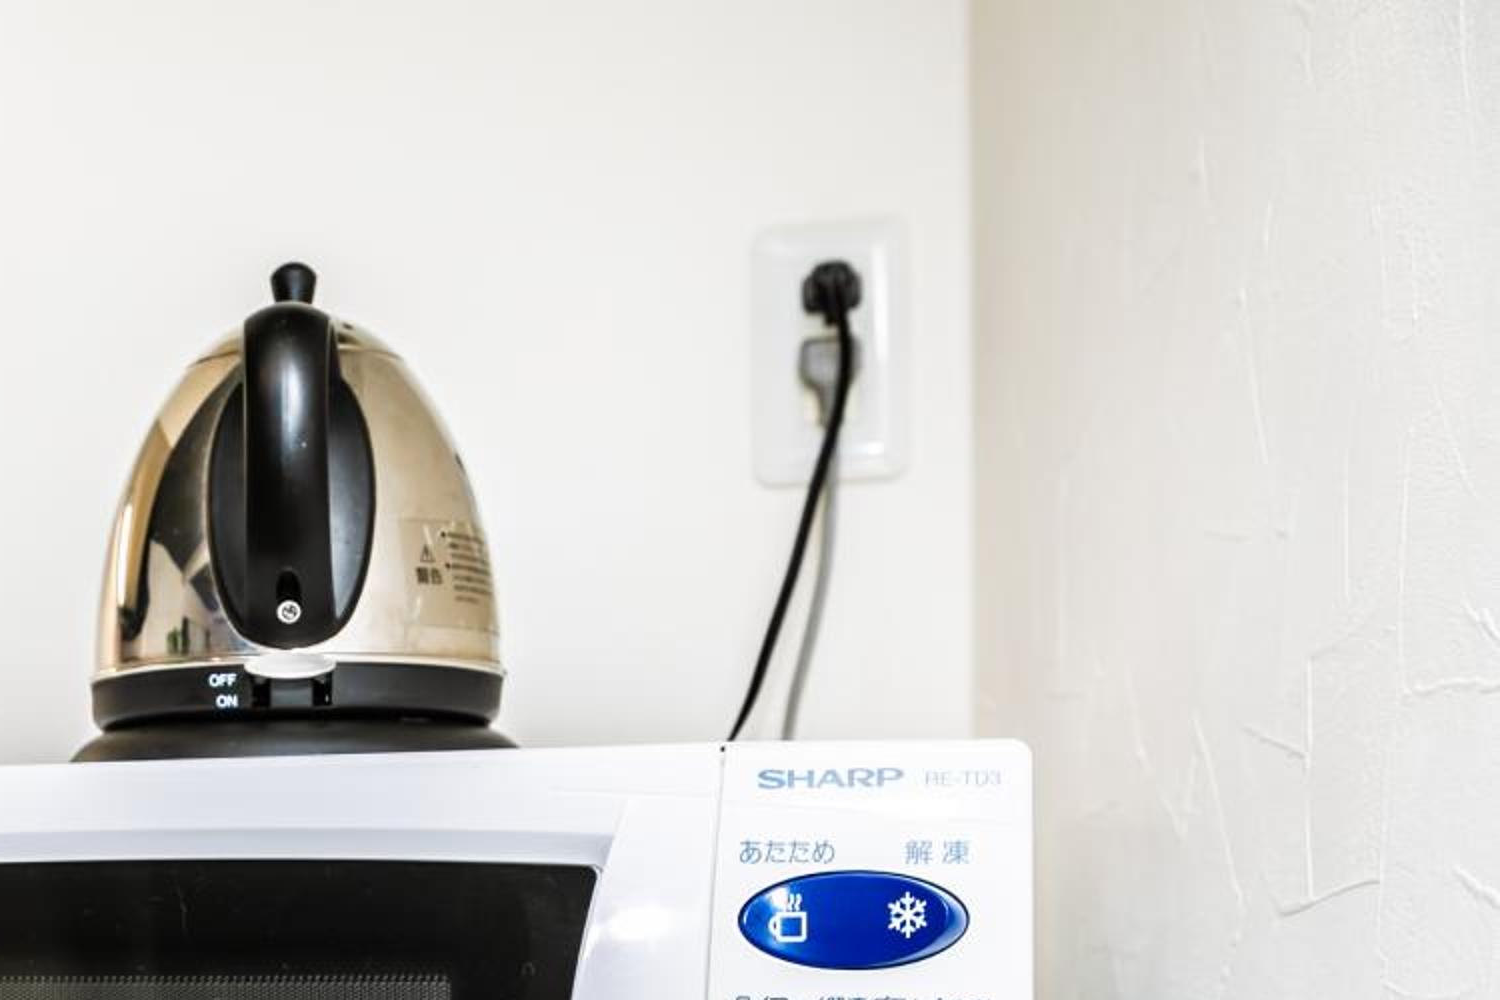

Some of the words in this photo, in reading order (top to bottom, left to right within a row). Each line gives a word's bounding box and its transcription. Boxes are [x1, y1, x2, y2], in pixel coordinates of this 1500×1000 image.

[209, 673, 237, 688] OFF
[215, 694, 239, 709] ON
[757, 768, 904, 789] SHARP
[739, 840, 835, 864] あたため
[904, 840, 970, 865] 解凍
